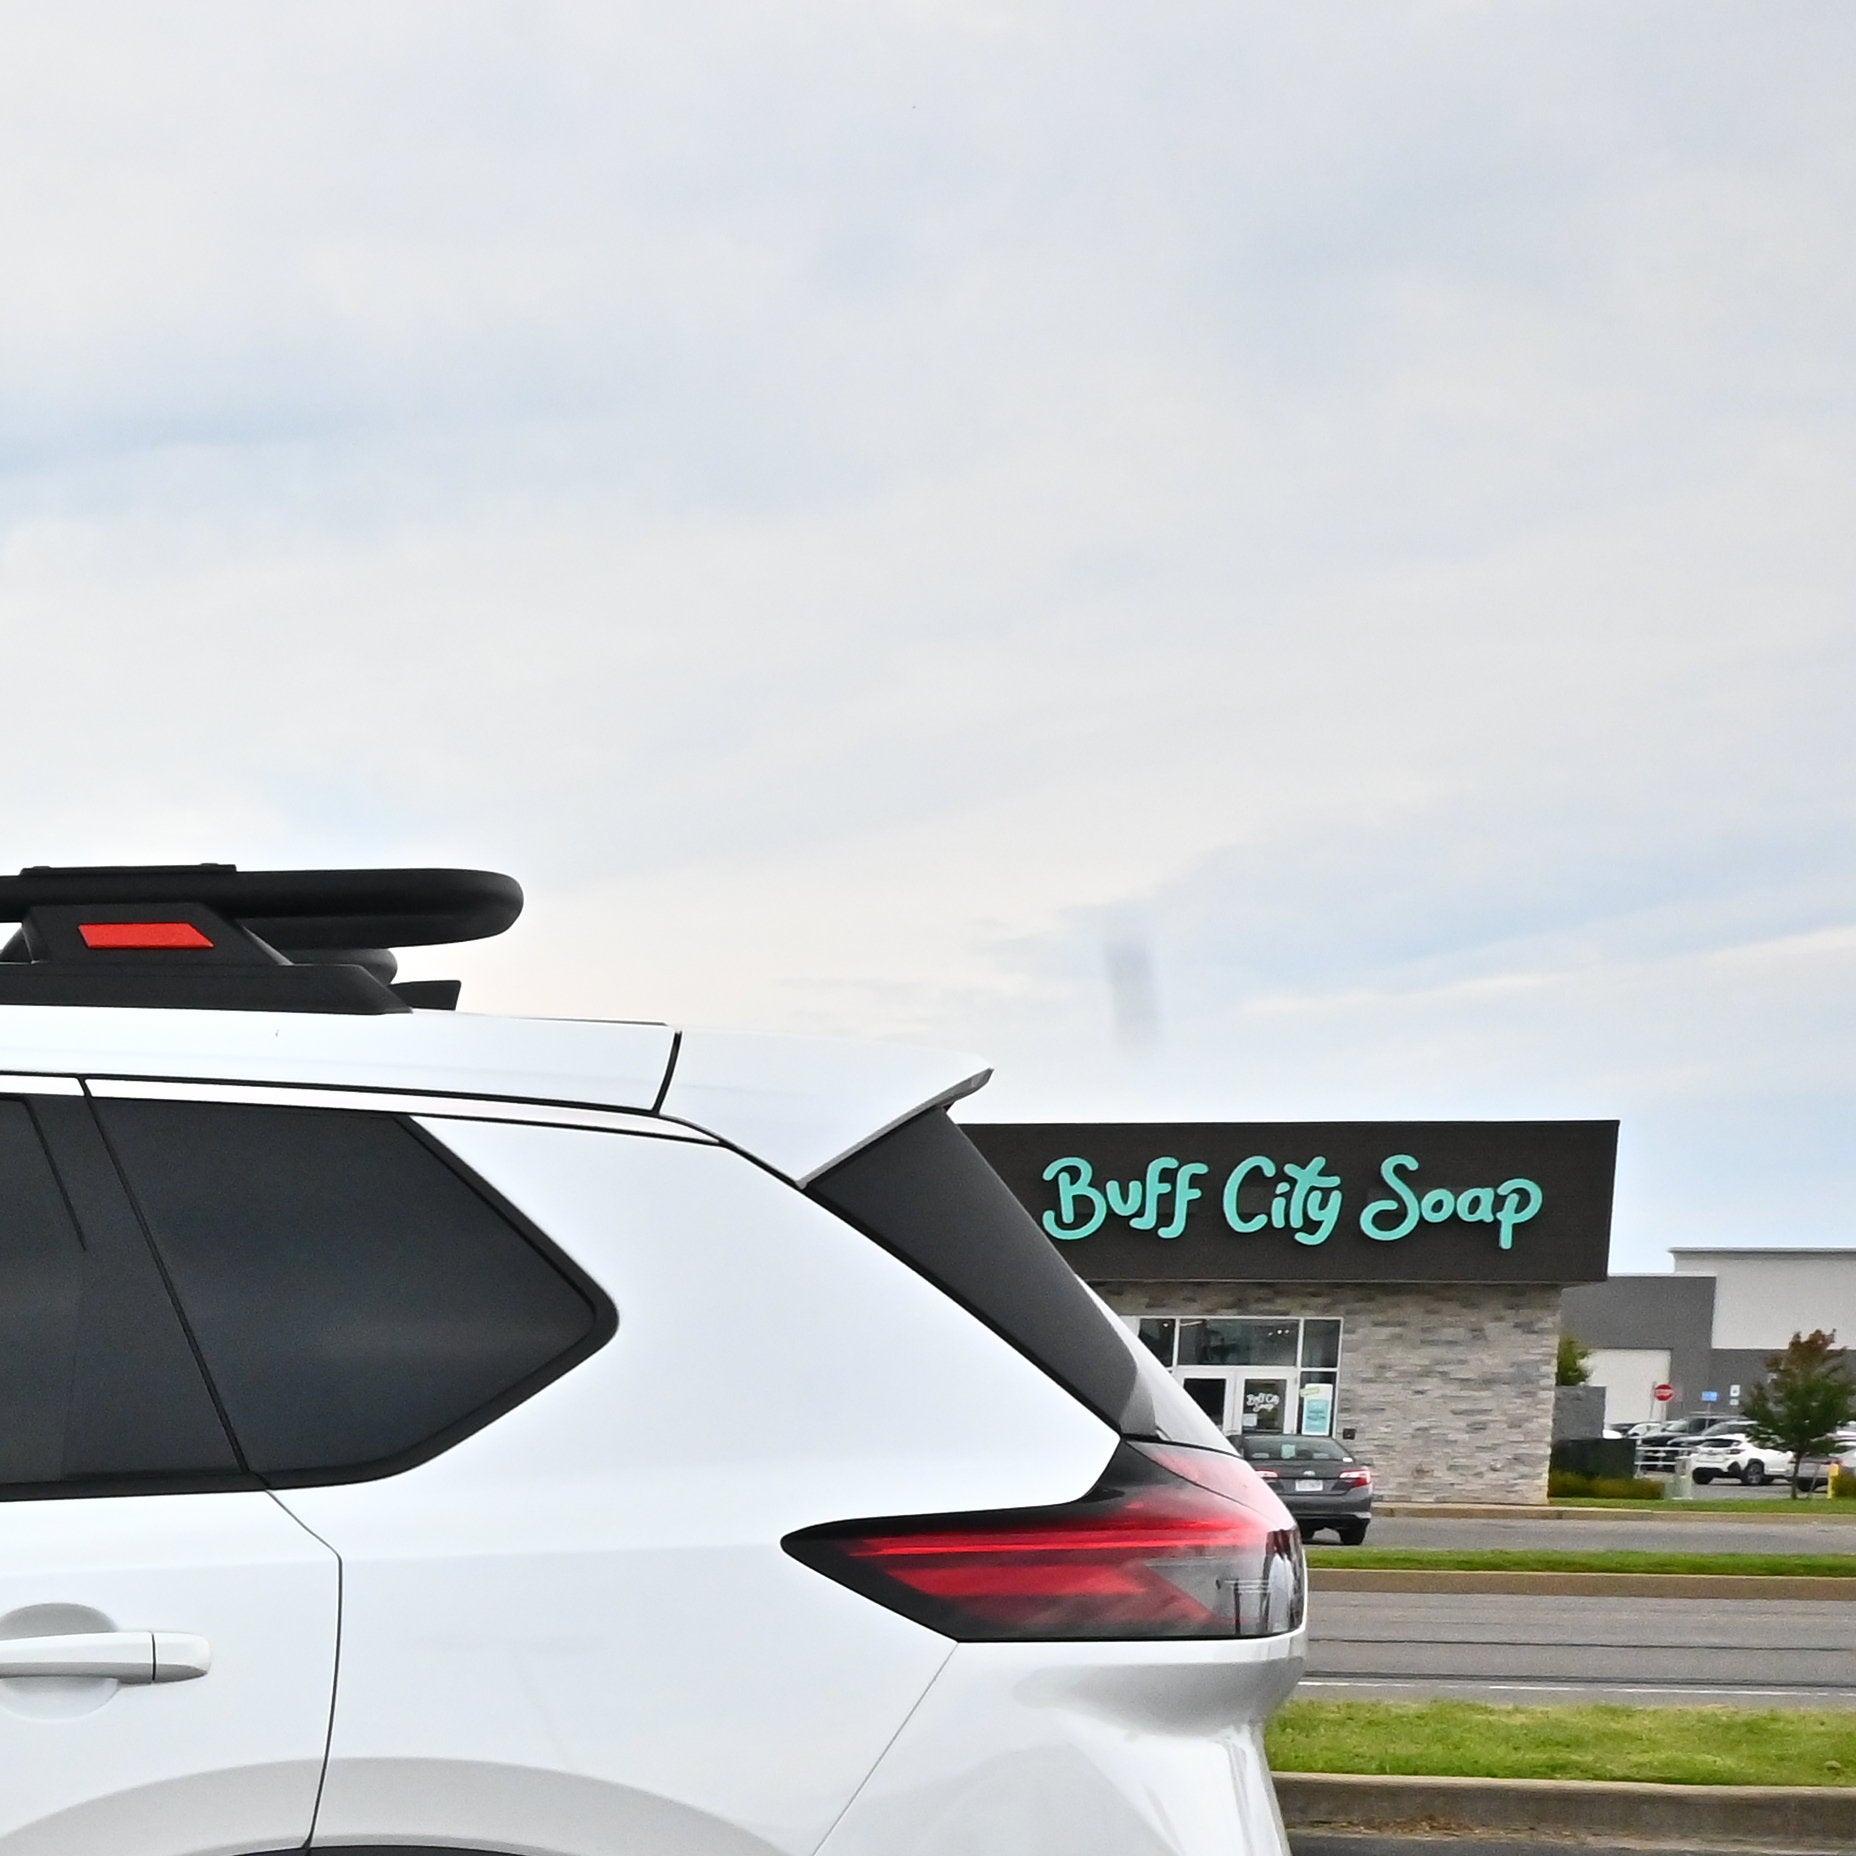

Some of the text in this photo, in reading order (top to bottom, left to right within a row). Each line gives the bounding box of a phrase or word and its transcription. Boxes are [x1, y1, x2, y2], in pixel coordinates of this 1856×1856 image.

[1043, 1154, 1543, 1250] Buff City Soap
